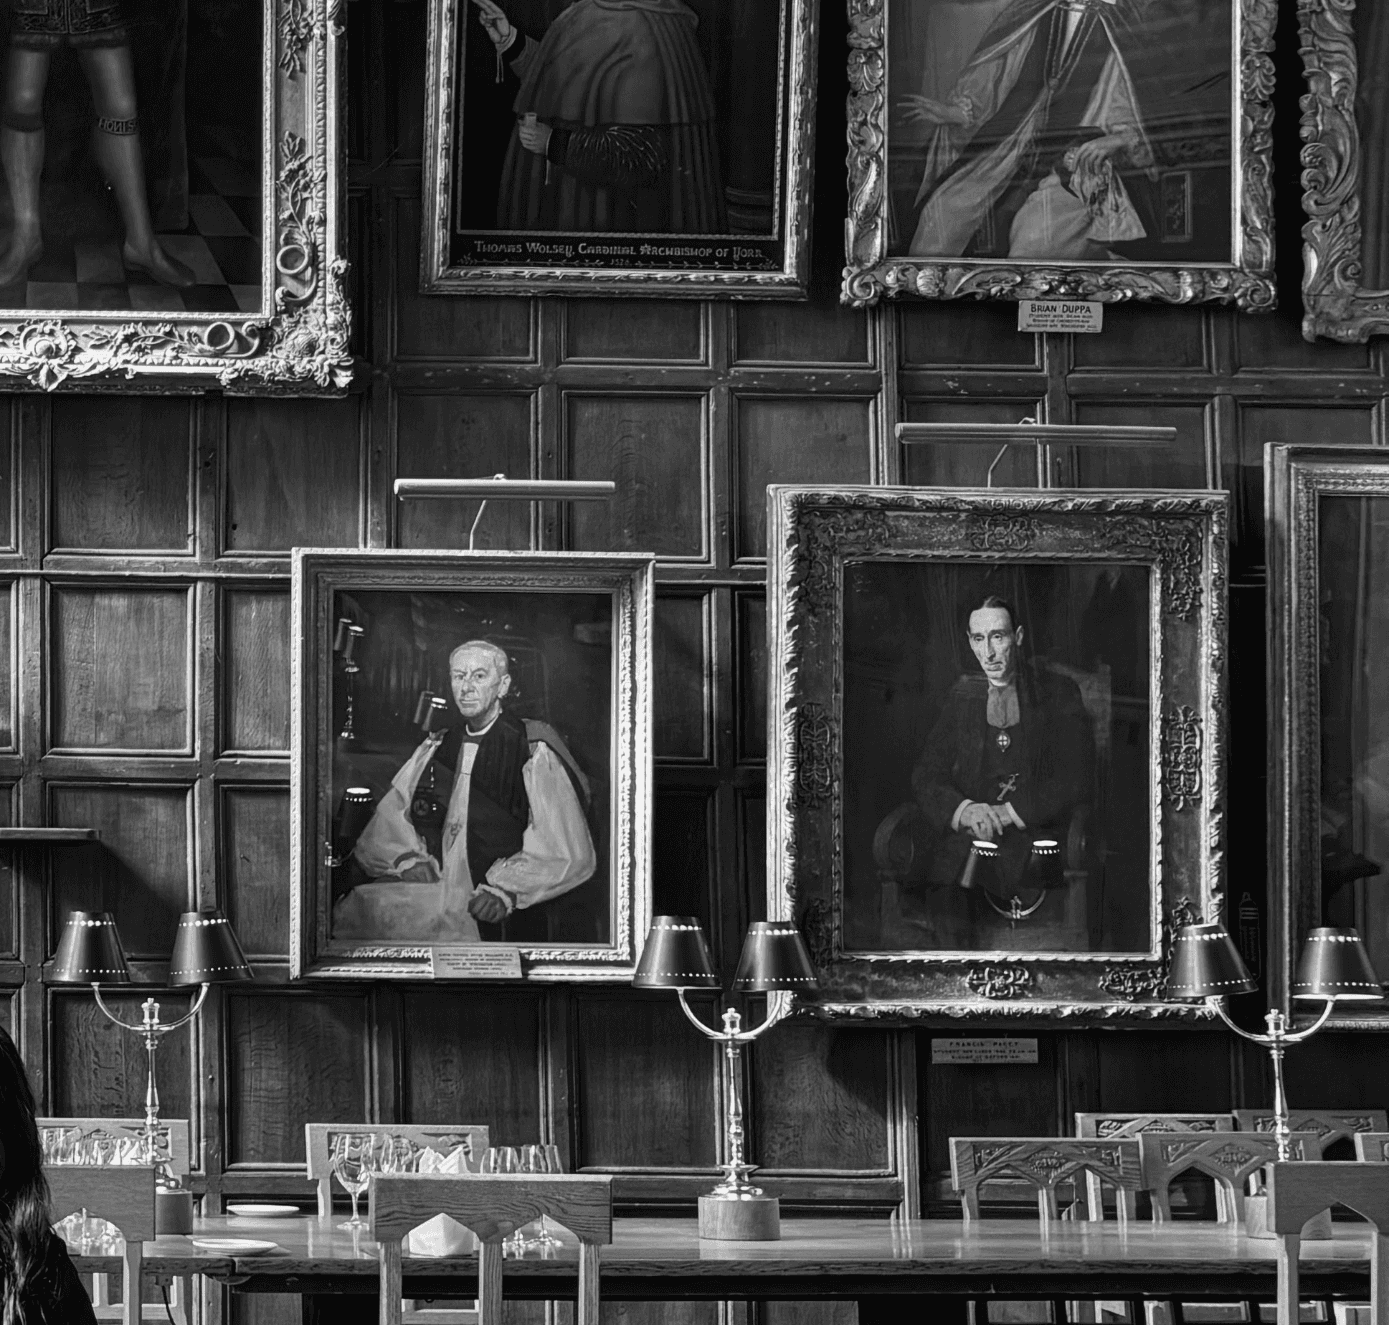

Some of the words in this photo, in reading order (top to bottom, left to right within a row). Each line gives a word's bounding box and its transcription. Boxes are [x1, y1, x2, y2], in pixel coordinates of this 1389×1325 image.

[473, 240, 522, 253] THOMAS
[715, 248, 730, 257] OF
[1030, 303, 1057, 313] BRIAN
[1062, 304, 1092, 314] DUPPA
